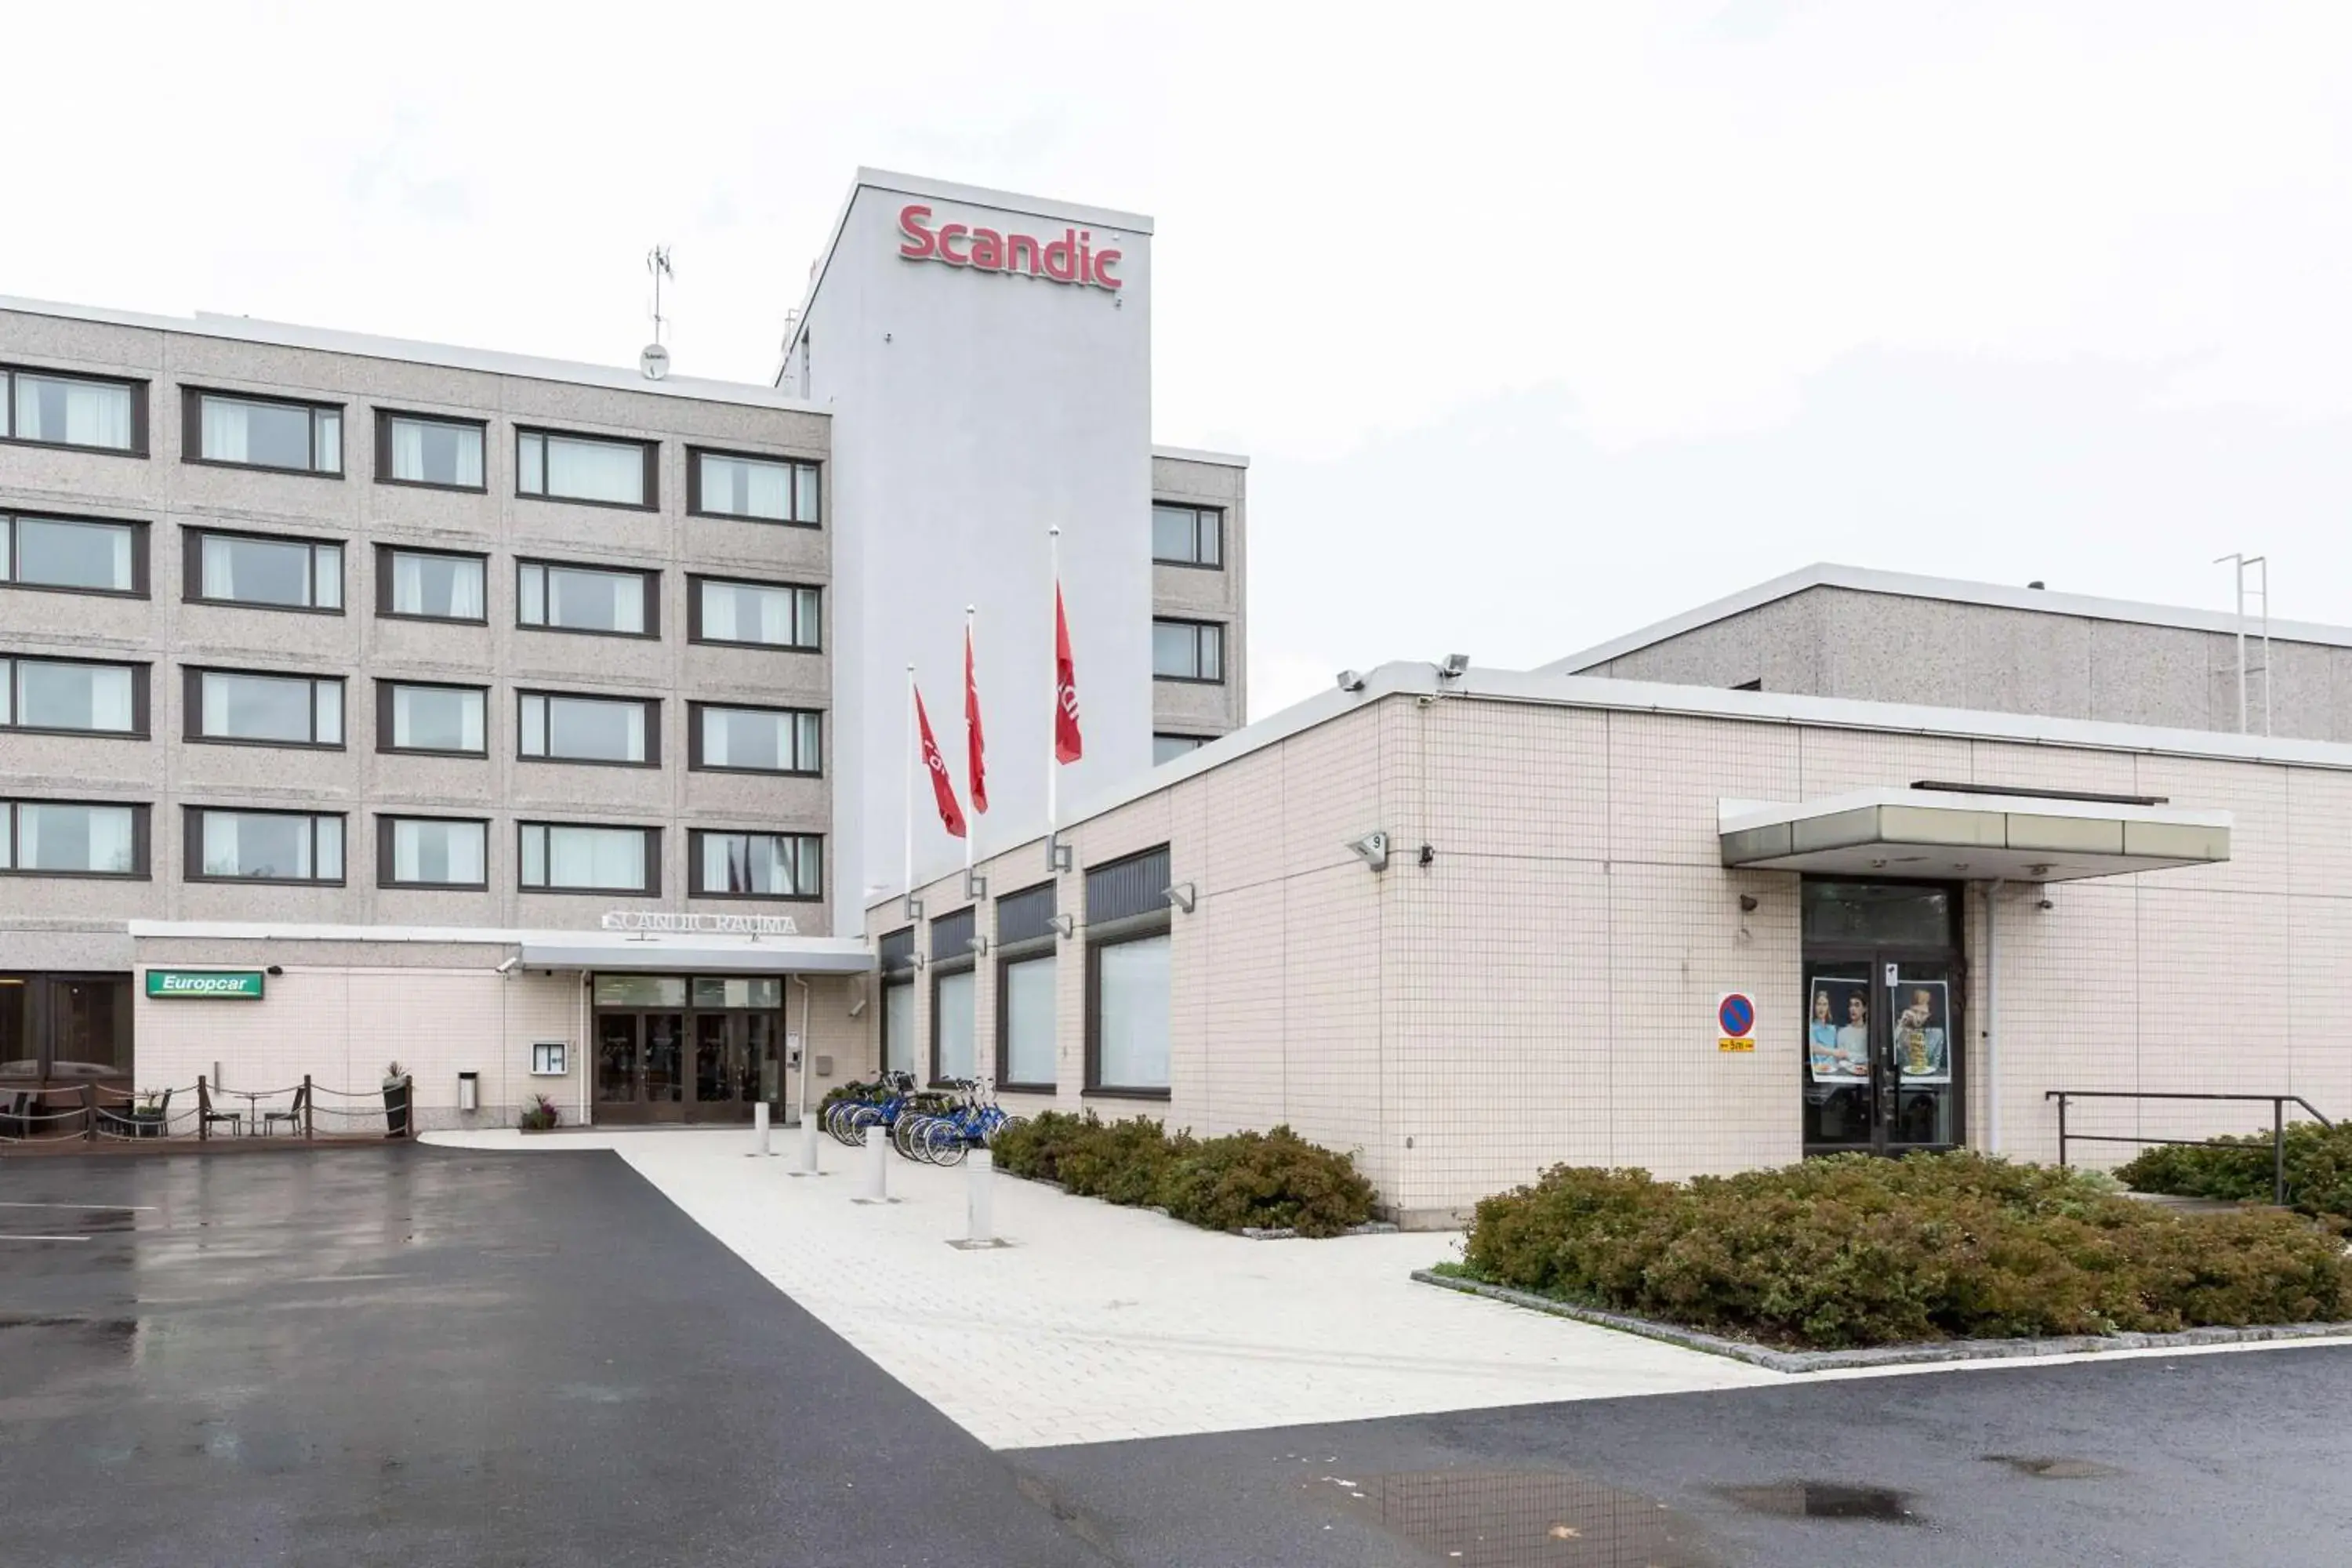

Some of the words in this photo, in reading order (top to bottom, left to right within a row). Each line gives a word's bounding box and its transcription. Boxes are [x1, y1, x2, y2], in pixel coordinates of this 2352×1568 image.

[899, 205, 1122, 289] Scandic
[1373, 835, 1381, 848] 9
[607, 910, 711, 931] SCANDIC
[715, 913, 799, 934] RAUMA
[162, 975, 247, 993] Europcar
